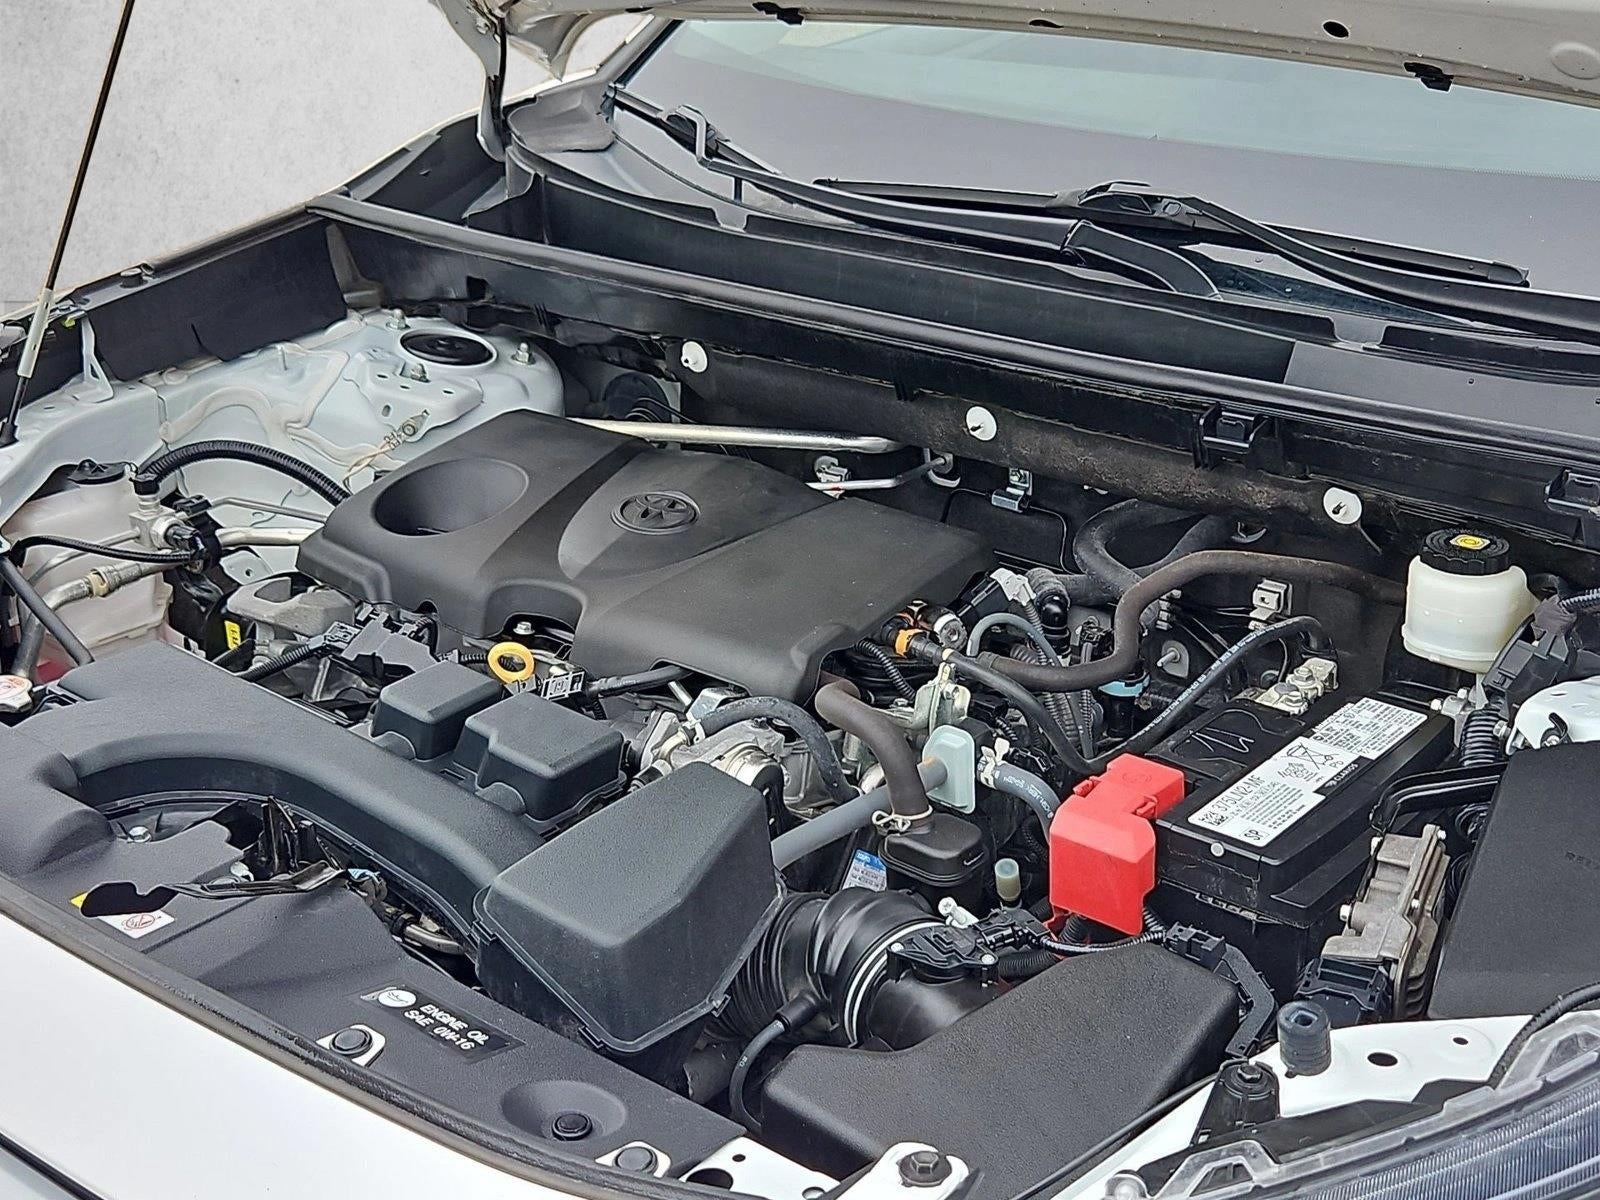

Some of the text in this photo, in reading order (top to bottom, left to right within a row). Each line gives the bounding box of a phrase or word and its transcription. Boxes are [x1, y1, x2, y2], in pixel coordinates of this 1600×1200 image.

[1334, 763, 1359, 781] CLARIOS
[1244, 829, 1263, 841] SP
[404, 1010, 476, 1050] SAE 0W-16
[420, 1004, 490, 1045] ENGINE OIL
